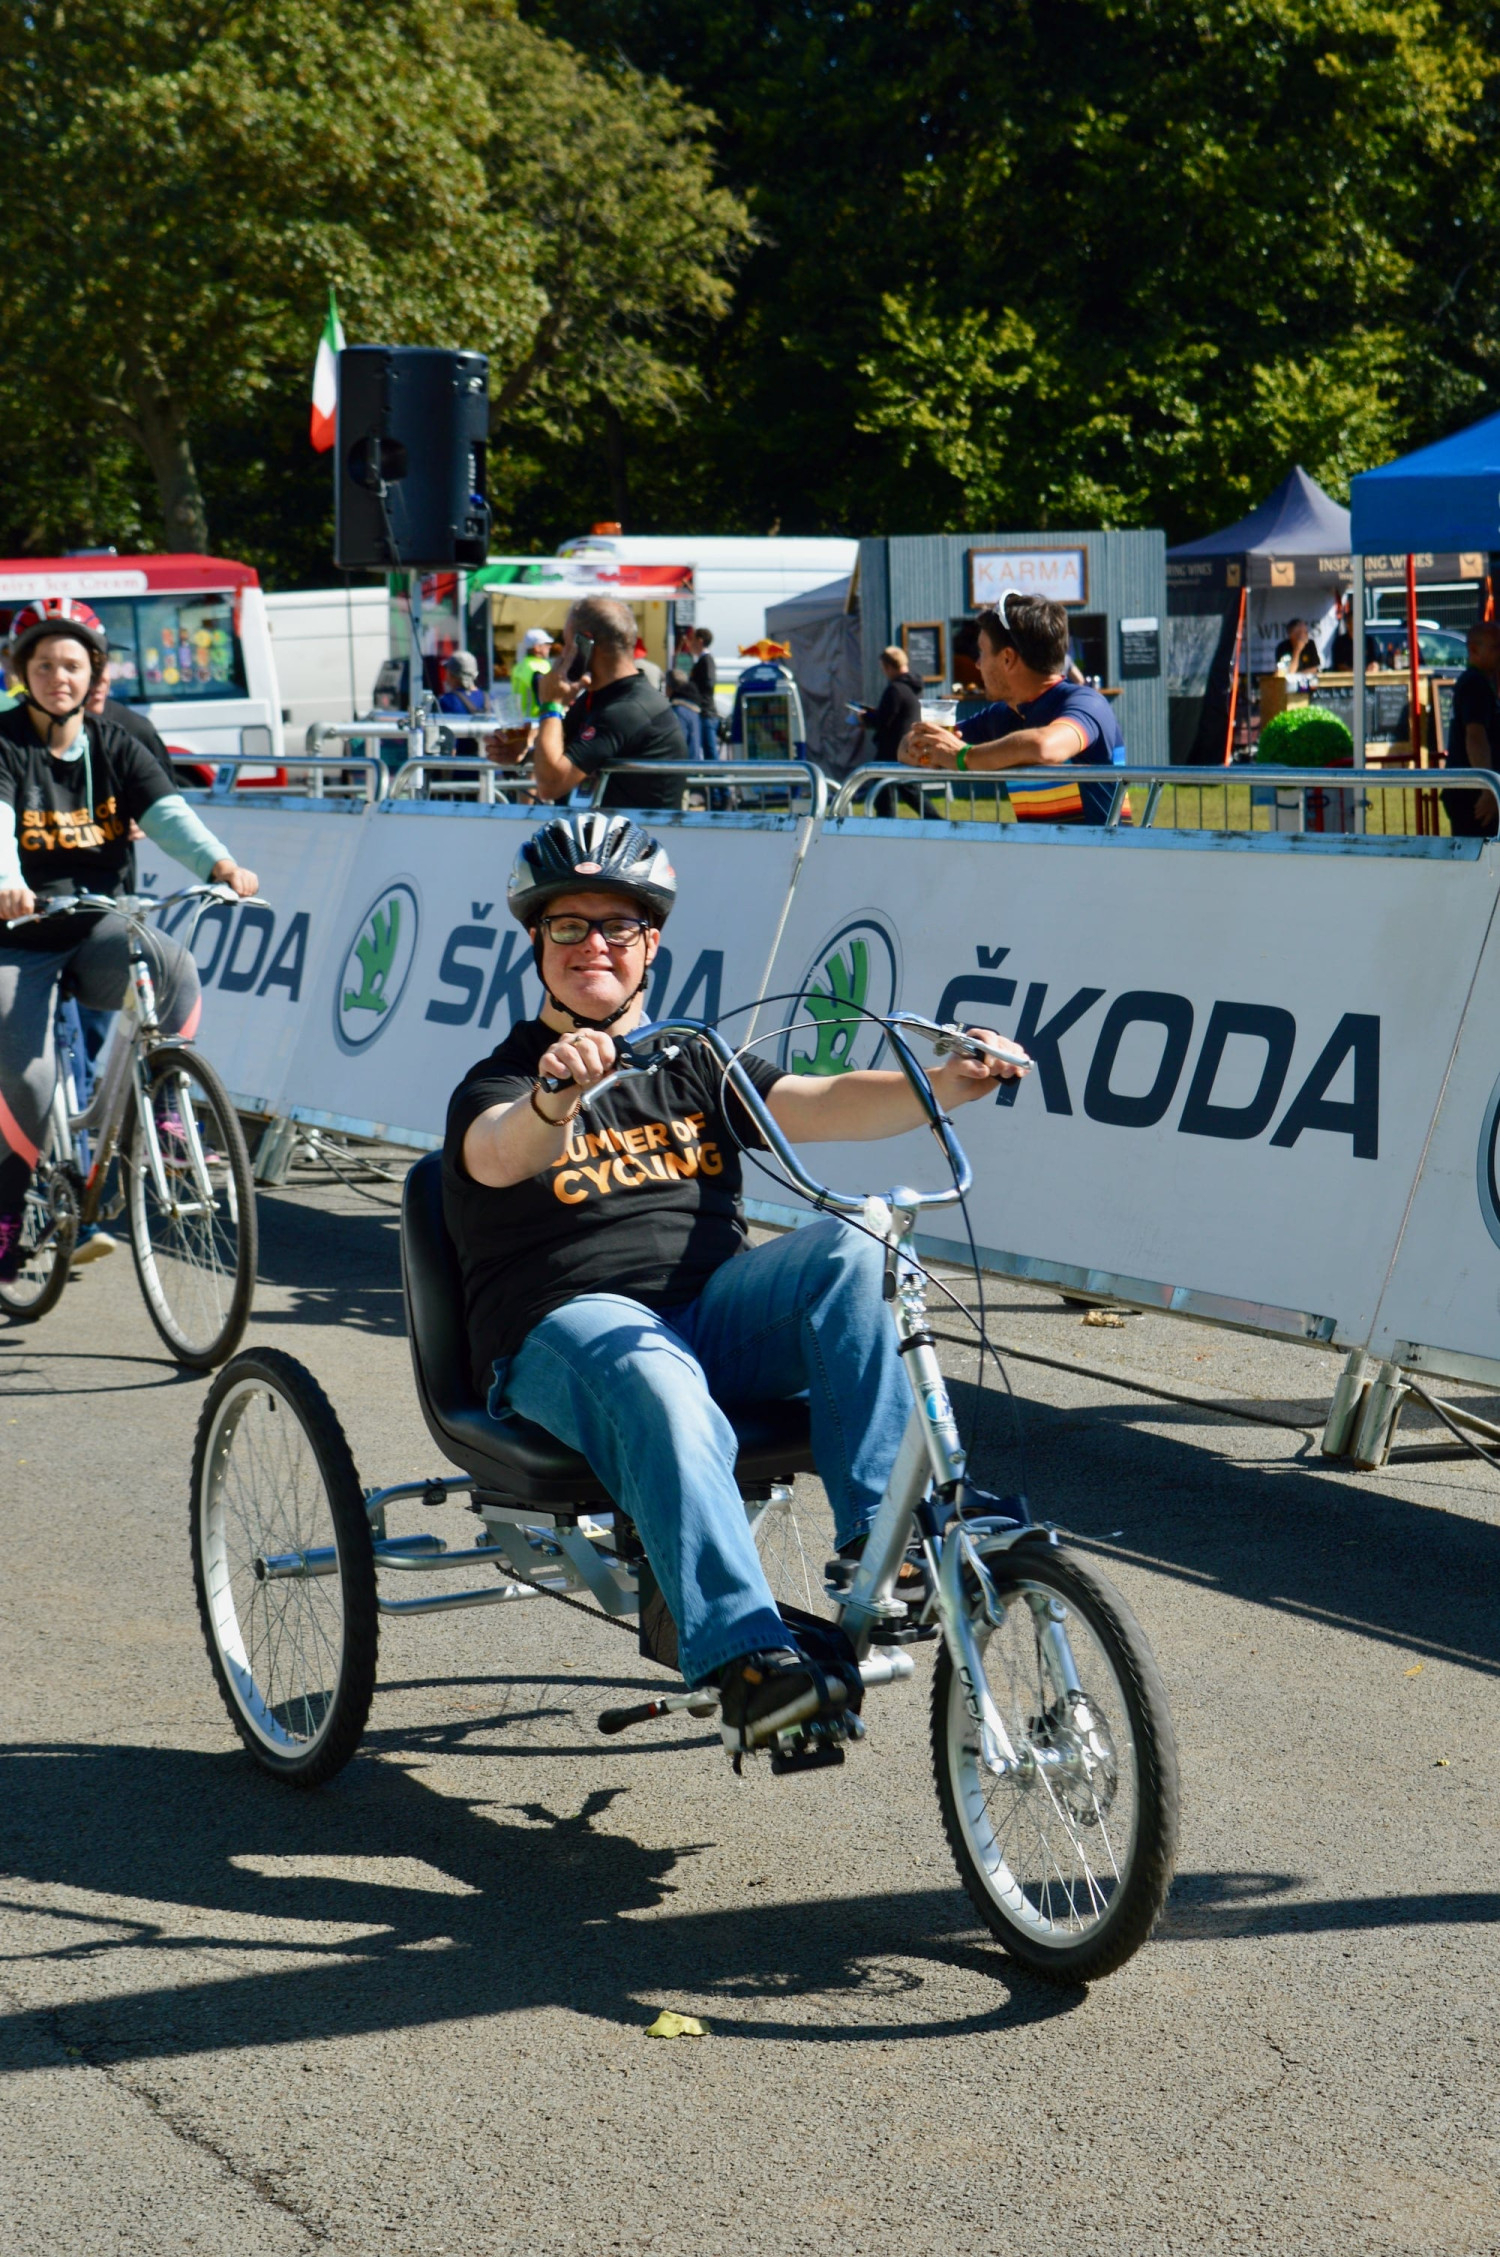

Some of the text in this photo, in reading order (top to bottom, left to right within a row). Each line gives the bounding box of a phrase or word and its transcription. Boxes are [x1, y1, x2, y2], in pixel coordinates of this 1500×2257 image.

[978, 560, 1079, 582] KARMA
[1318, 552, 1434, 572] INSPING WIES
[0, 577, 35, 593] airy
[78, 573, 140, 590] Cream
[22, 807, 94, 828] SUMME
[21, 824, 124, 851] CYCLING
[552, 1112, 706, 1167] UMMER OF
[553, 1142, 723, 1204] CYCLING
